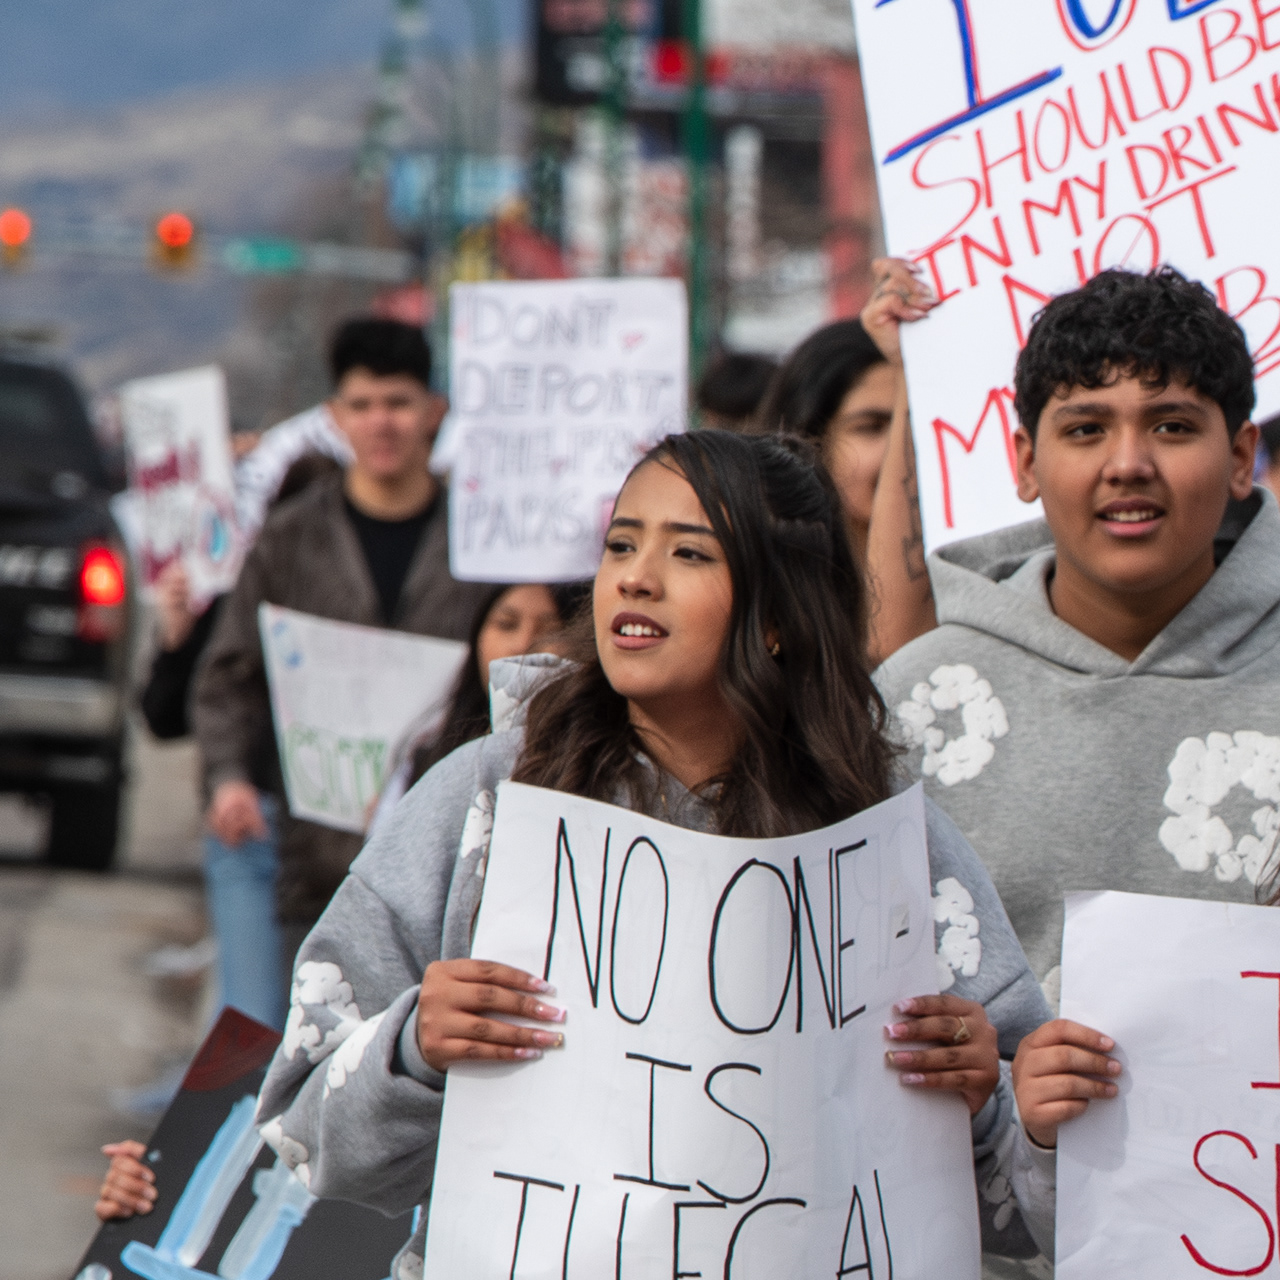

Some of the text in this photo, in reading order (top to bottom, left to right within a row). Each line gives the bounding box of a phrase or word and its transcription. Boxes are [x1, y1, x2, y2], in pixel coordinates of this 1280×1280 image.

[907, 47, 1192, 256] SHOULD
[912, 216, 1012, 301] IN
[1022, 160, 1107, 256] MY
[543, 816, 868, 1036] NO ONE
[612, 1051, 770, 1204] IS
